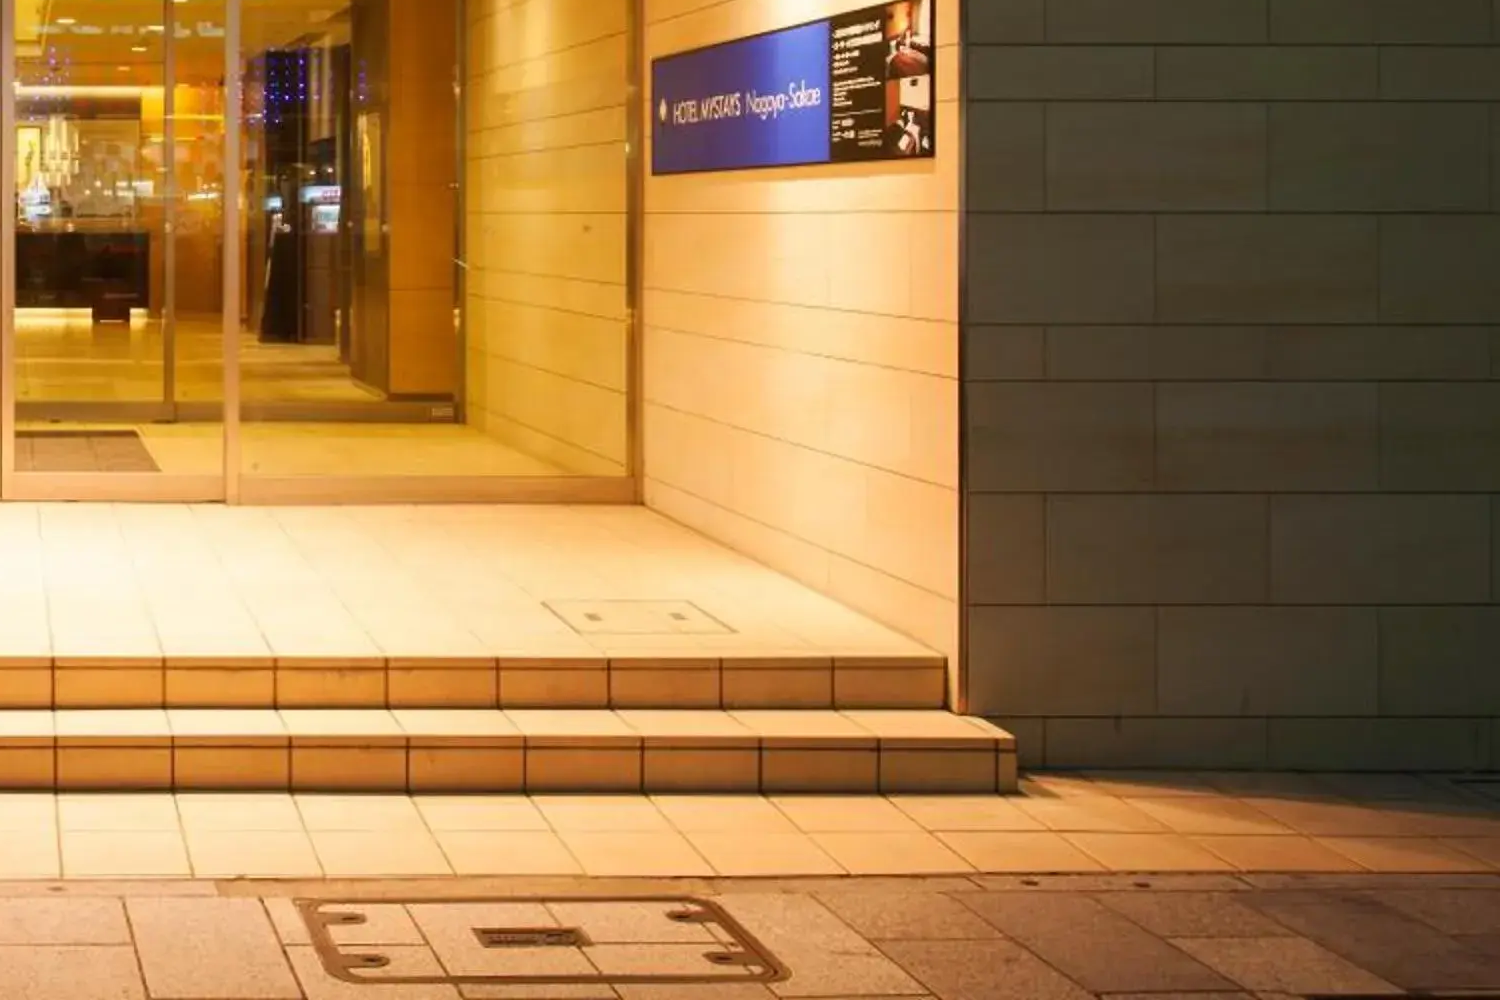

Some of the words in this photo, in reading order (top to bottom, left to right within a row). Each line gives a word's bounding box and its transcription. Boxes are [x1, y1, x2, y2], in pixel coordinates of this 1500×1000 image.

[673, 99, 699, 126] HOTEL
[700, 92, 742, 120] MYSTAYS
[745, 79, 821, 120] Nagoya-Sakae
